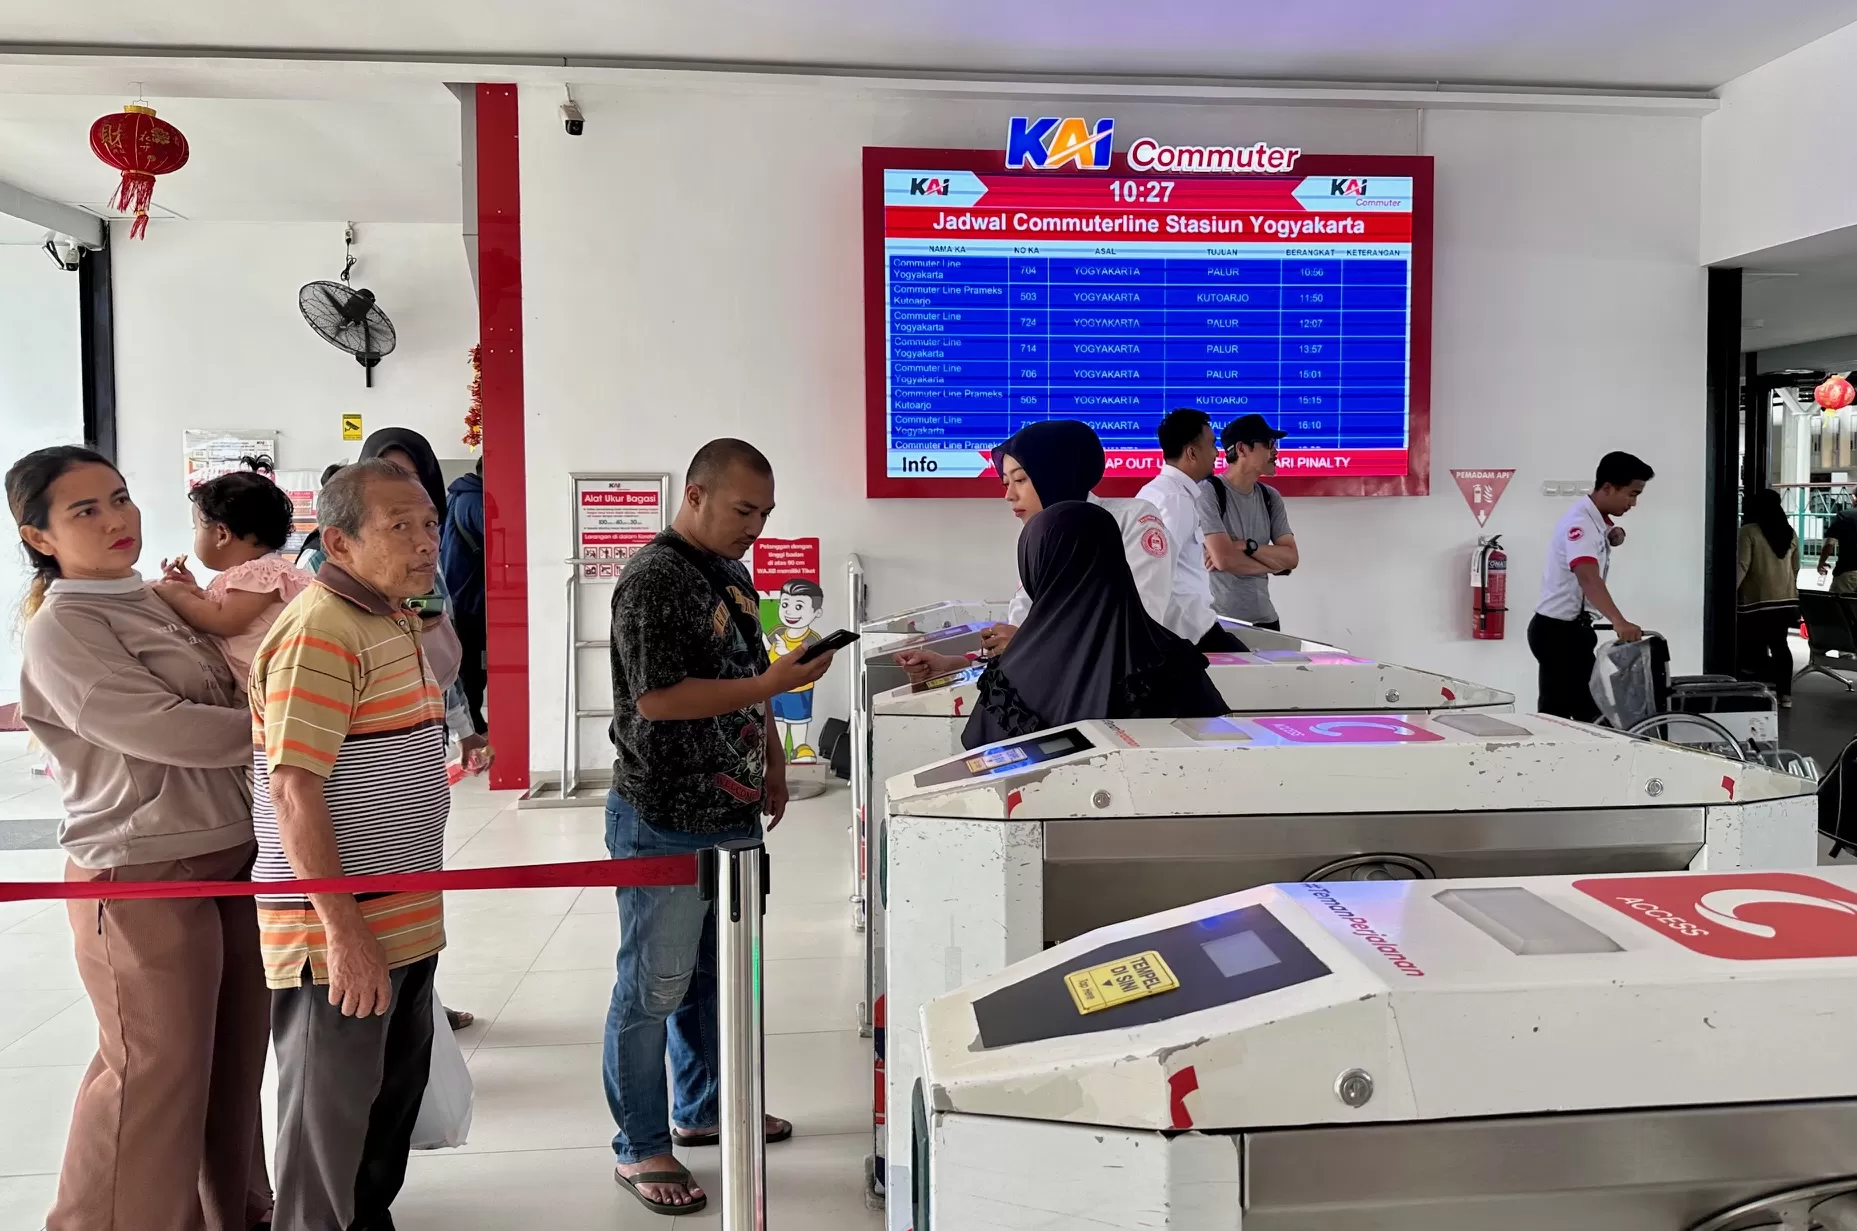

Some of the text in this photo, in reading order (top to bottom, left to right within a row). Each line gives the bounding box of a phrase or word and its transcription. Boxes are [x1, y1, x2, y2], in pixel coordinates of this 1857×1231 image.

[1005, 117, 1115, 170] KAI
[1128, 137, 1301, 172] Commuter
[910, 178, 949, 195] KAI
[1331, 179, 1367, 195] KAI
[1109, 180, 1175, 203] 10:27
[1356, 198, 1401, 207] Commuter
[933, 212, 1365, 237] Jadwal Commuterline Stasiun Yogyakarta
[929, 245, 952, 253] NAMA
[1095, 247, 1116, 255] ASAL
[1207, 248, 1238, 256] TUJUAN
[894, 258, 961, 268] Commuter Line
[894, 270, 944, 281] Yogyakarta
[1074, 267, 1140, 276] YOGYAKARTA
[1207, 267, 1238, 276] PALUR
[894, 285, 1002, 294] Commuter Line Prameks
[894, 296, 931, 306] Kutoarjo
[1020, 292, 1036, 301] 503
[1074, 293, 1140, 302] YOGYAKARTA
[1197, 292, 1249, 302] KUTOARJO
[1299, 292, 1323, 302] 11:50
[894, 311, 961, 321] Commuter Line
[1020, 318, 1036, 327] 724
[1074, 319, 1140, 328] YOGYAKARTA
[1207, 319, 1238, 328] PALUR
[1299, 318, 1323, 328] 12:07
[894, 323, 944, 333] Yogyakarta
[895, 337, 961, 347] Commuter Line
[1020, 344, 1036, 352] 714
[1074, 345, 1140, 353] YOGYAKARTA
[1207, 345, 1238, 353] PALUR
[1299, 344, 1323, 353] 13:57
[895, 349, 944, 359] Yogyakarta
[895, 363, 961, 372] Commuter Line
[1299, 370, 1323, 378] 15:01
[895, 375, 944, 385] Yogyakarta
[895, 389, 1002, 398] Commuter Line Prameks
[1197, 396, 1249, 404] KUTOARJO
[1299, 396, 1323, 404] 15:15
[895, 400, 931, 410] Kutoarjo
[895, 415, 961, 424] Commuter Line
[1299, 421, 1322, 429] 16:10
[895, 426, 944, 435] Yogyakarta
[895, 441, 941, 450] Commuter
[944, 441, 961, 450] Line
[902, 456, 938, 472] Info
[1105, 458, 1123, 469] AP
[1125, 458, 1153, 469] OUT
[1297, 456, 1351, 468] PINALTY
[626, 495, 656, 504] Bagasi
[1615, 896, 1709, 937] ACCESS
[1301, 883, 1424, 976] #TemanPerjalanan
[1129, 957, 1161, 989] TEMPEL
[1111, 965, 1139, 993] DI SINI
